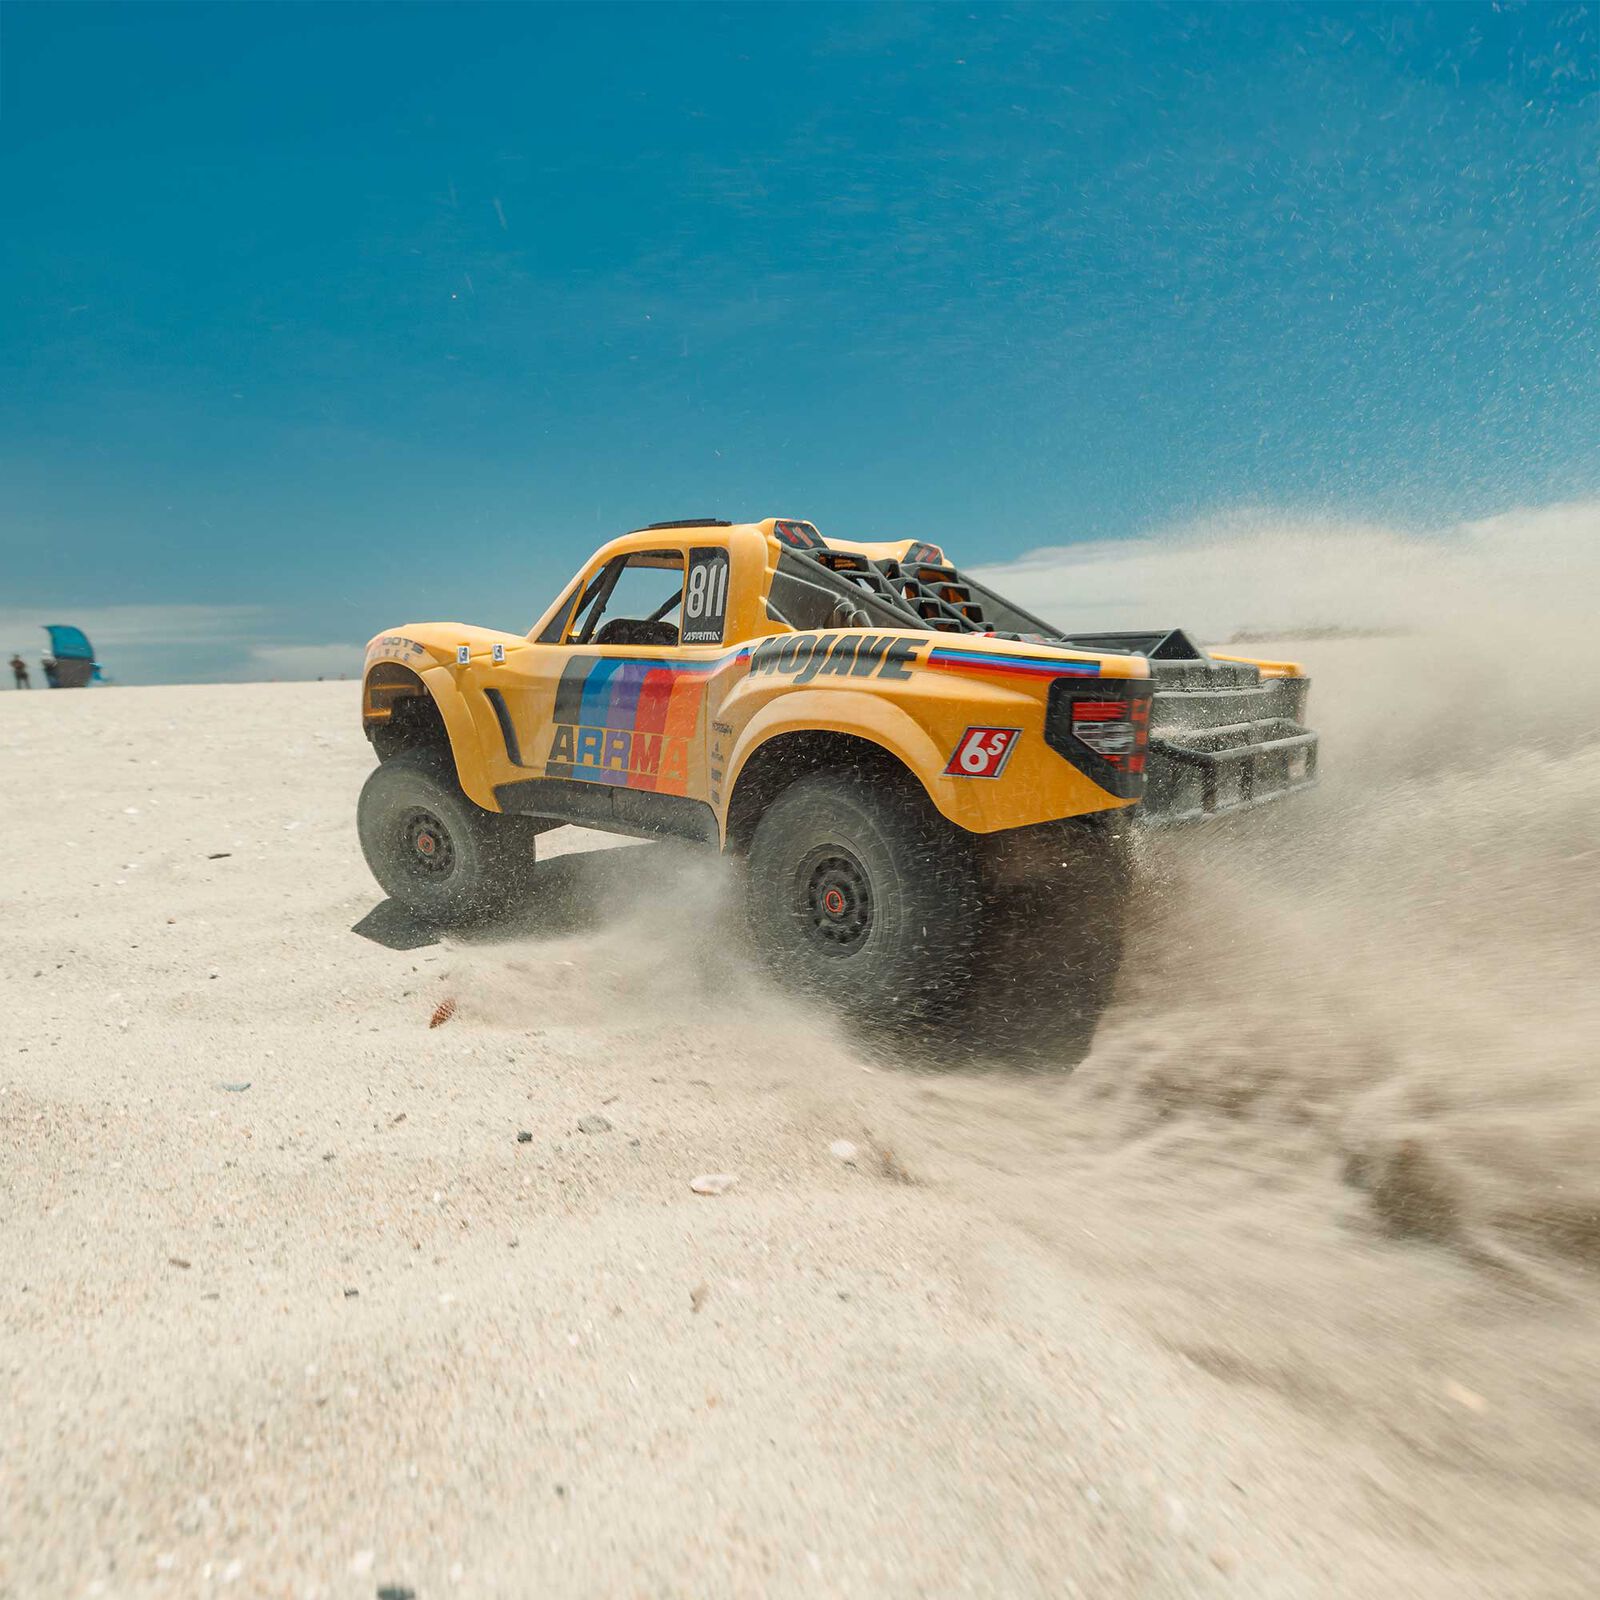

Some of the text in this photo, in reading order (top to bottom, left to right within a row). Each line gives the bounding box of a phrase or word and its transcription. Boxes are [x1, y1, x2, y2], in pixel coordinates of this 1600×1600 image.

[687, 565, 728, 618] 811
[684, 631, 721, 641] ARRMA
[750, 634, 929, 684] MOJAVE
[548, 725, 688, 778] ARRMA
